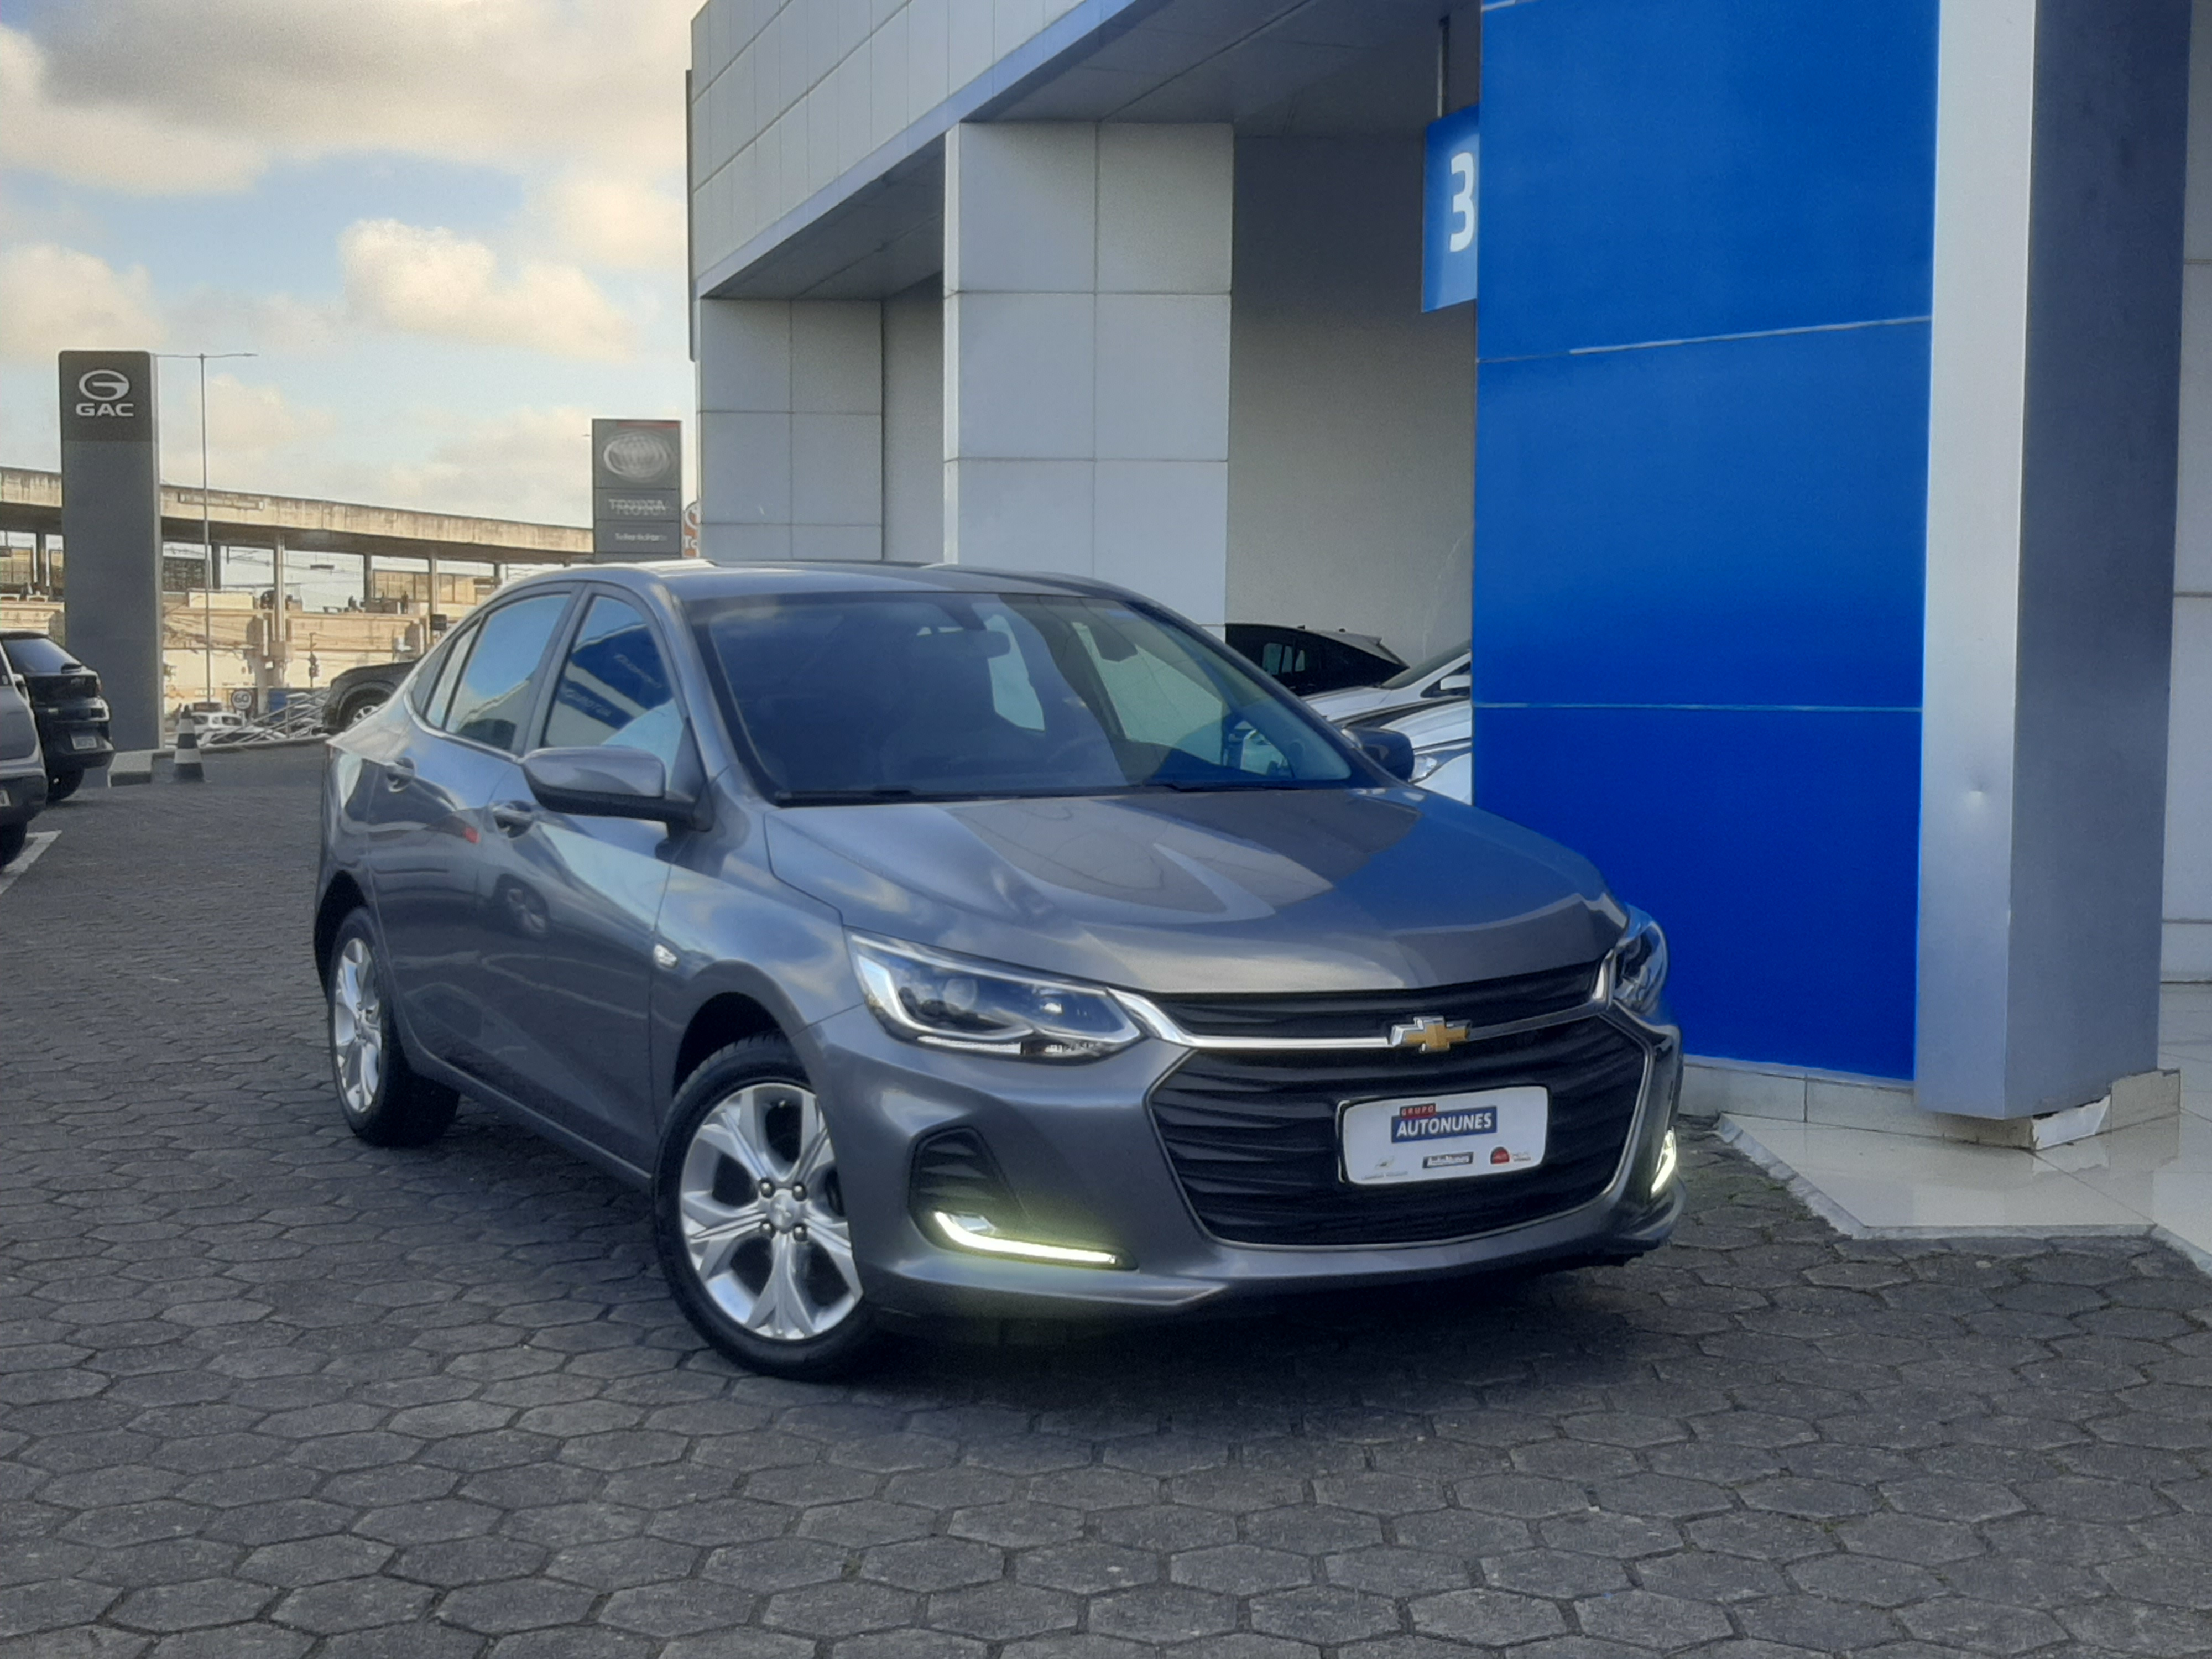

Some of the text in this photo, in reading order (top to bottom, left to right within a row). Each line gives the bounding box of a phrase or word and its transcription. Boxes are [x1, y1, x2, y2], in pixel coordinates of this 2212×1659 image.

[1449, 152, 1475, 252] 3
[76, 403, 134, 417] GAC
[234, 693, 249, 703] 60
[1401, 1105, 1434, 1116] GRUPO
[1396, 1113, 1492, 1138] AUTONUNES
